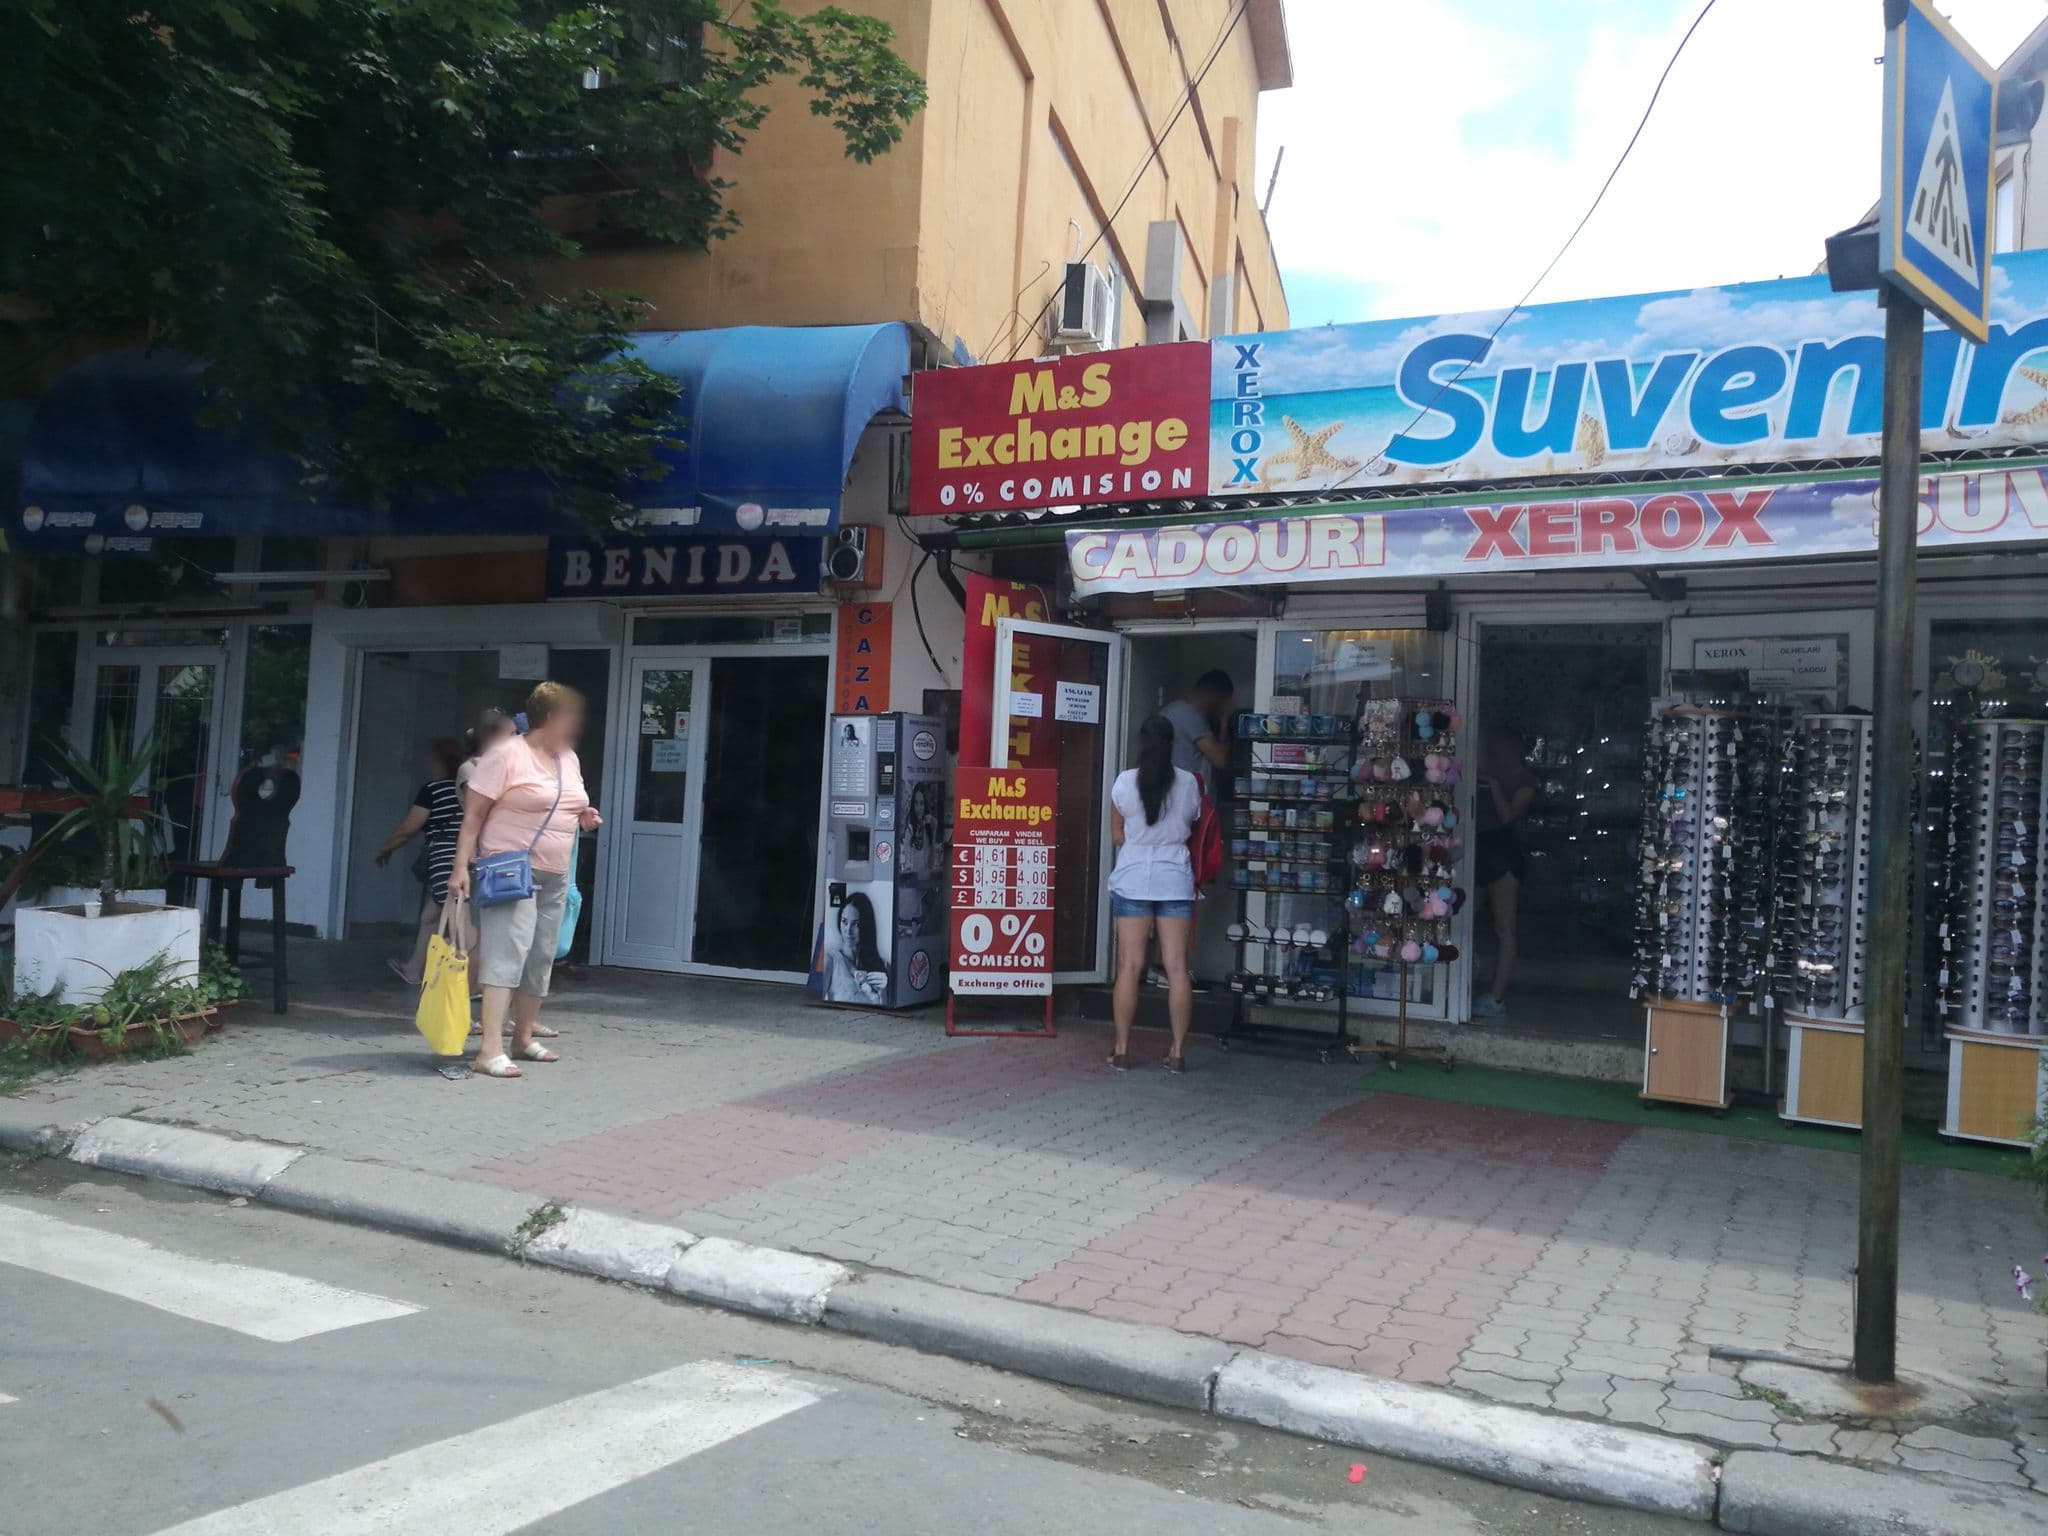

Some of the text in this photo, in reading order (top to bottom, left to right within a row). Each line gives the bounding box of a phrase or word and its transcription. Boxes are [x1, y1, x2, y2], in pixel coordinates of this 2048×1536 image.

[1009, 363, 1111, 416] M&S
[1230, 342, 1264, 485] XEROX
[938, 417, 1188, 469] Exchange
[1000, 467, 1192, 502] COMISION
[1070, 514, 1386, 582] CADOURI
[1463, 489, 1778, 562] XEROX
[564, 540, 797, 587] BENIDA
[855, 609, 873, 711] CAZA
[1705, 648, 1746, 659] XEROX
[988, 777, 1026, 797] M&S
[960, 799, 1052, 826] Exchange
[960, 913, 1045, 954] 0%
[958, 955, 1045, 967] COMISION
[958, 979, 1045, 989] Exchange Office
